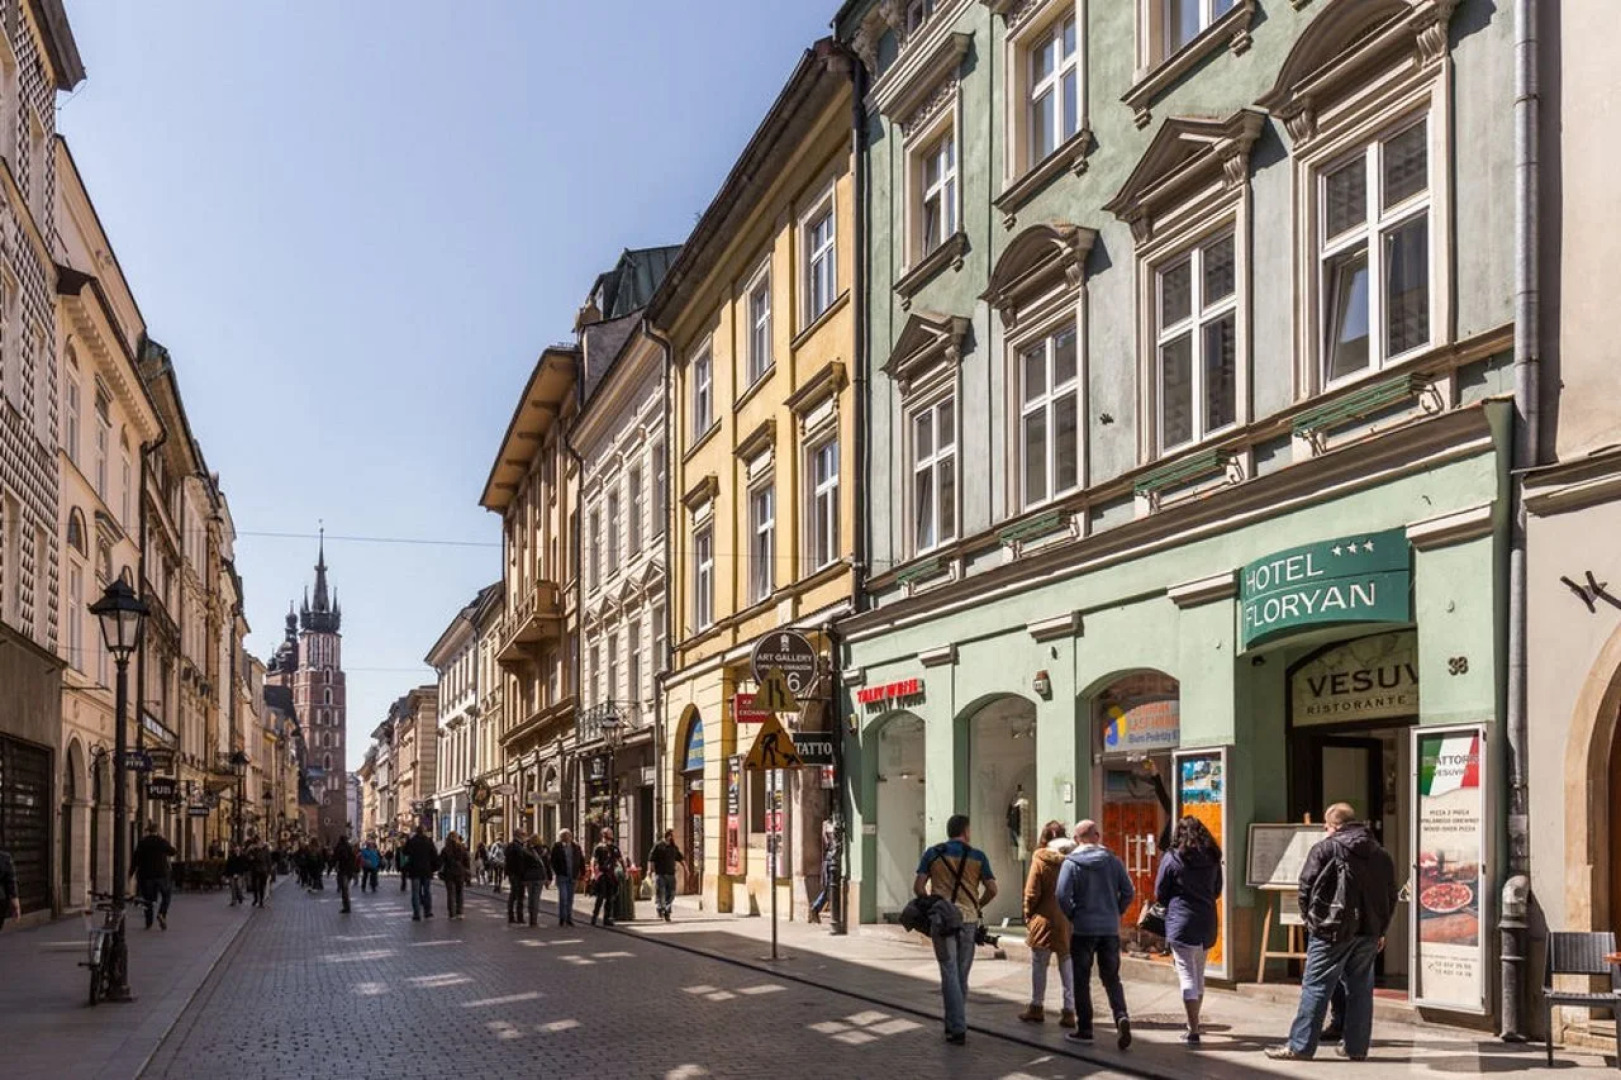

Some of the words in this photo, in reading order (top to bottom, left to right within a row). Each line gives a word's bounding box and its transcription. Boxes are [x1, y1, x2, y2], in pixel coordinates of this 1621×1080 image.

[1246, 553, 1324, 595] HOTEL
[1246, 583, 1375, 627] FLORYAN
[756, 653, 773, 662] ART
[774, 653, 813, 662] GALLERY
[1448, 656, 1469, 676] 38
[786, 671, 800, 692] 6
[1307, 695, 1407, 715] RISTORANTE
